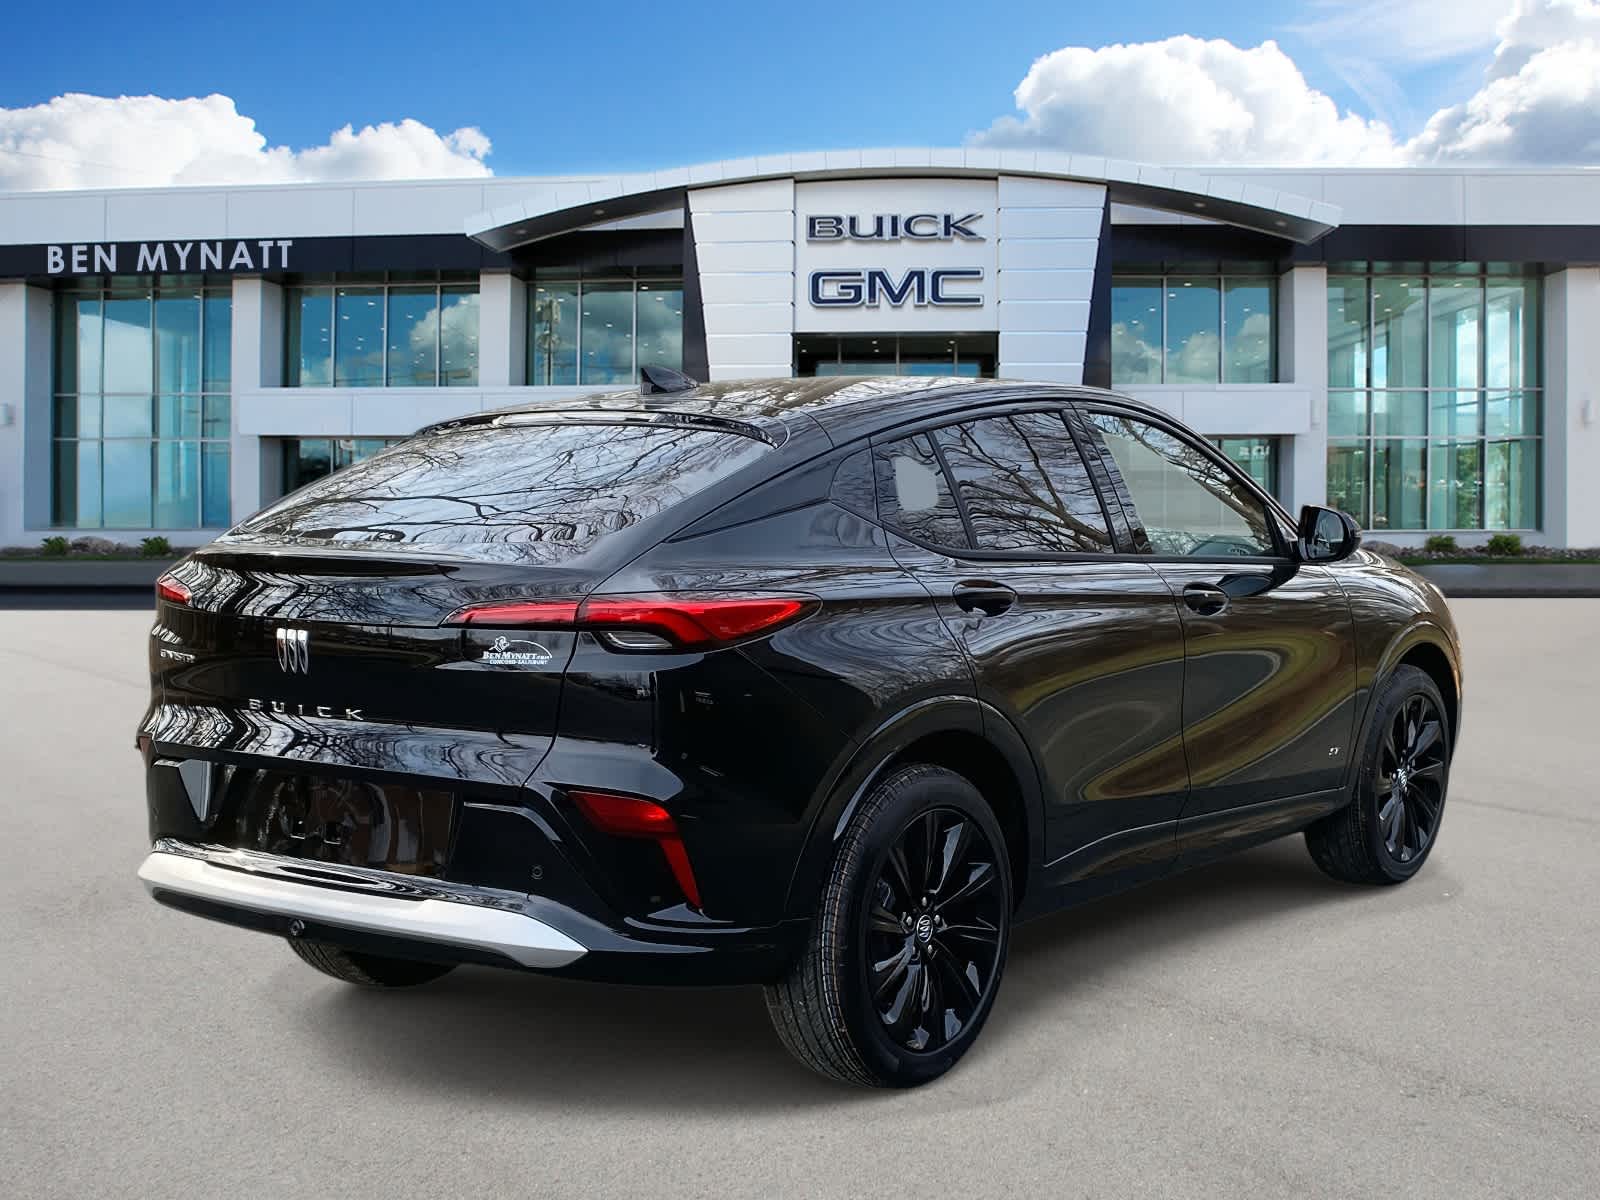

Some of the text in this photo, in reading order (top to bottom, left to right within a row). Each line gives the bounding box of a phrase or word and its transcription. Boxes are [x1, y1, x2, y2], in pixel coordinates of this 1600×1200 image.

[807, 213, 985, 242] BUICK
[47, 240, 293, 274] BEN MYNATT
[808, 267, 984, 307] GMC
[248, 698, 364, 721] BUICK
